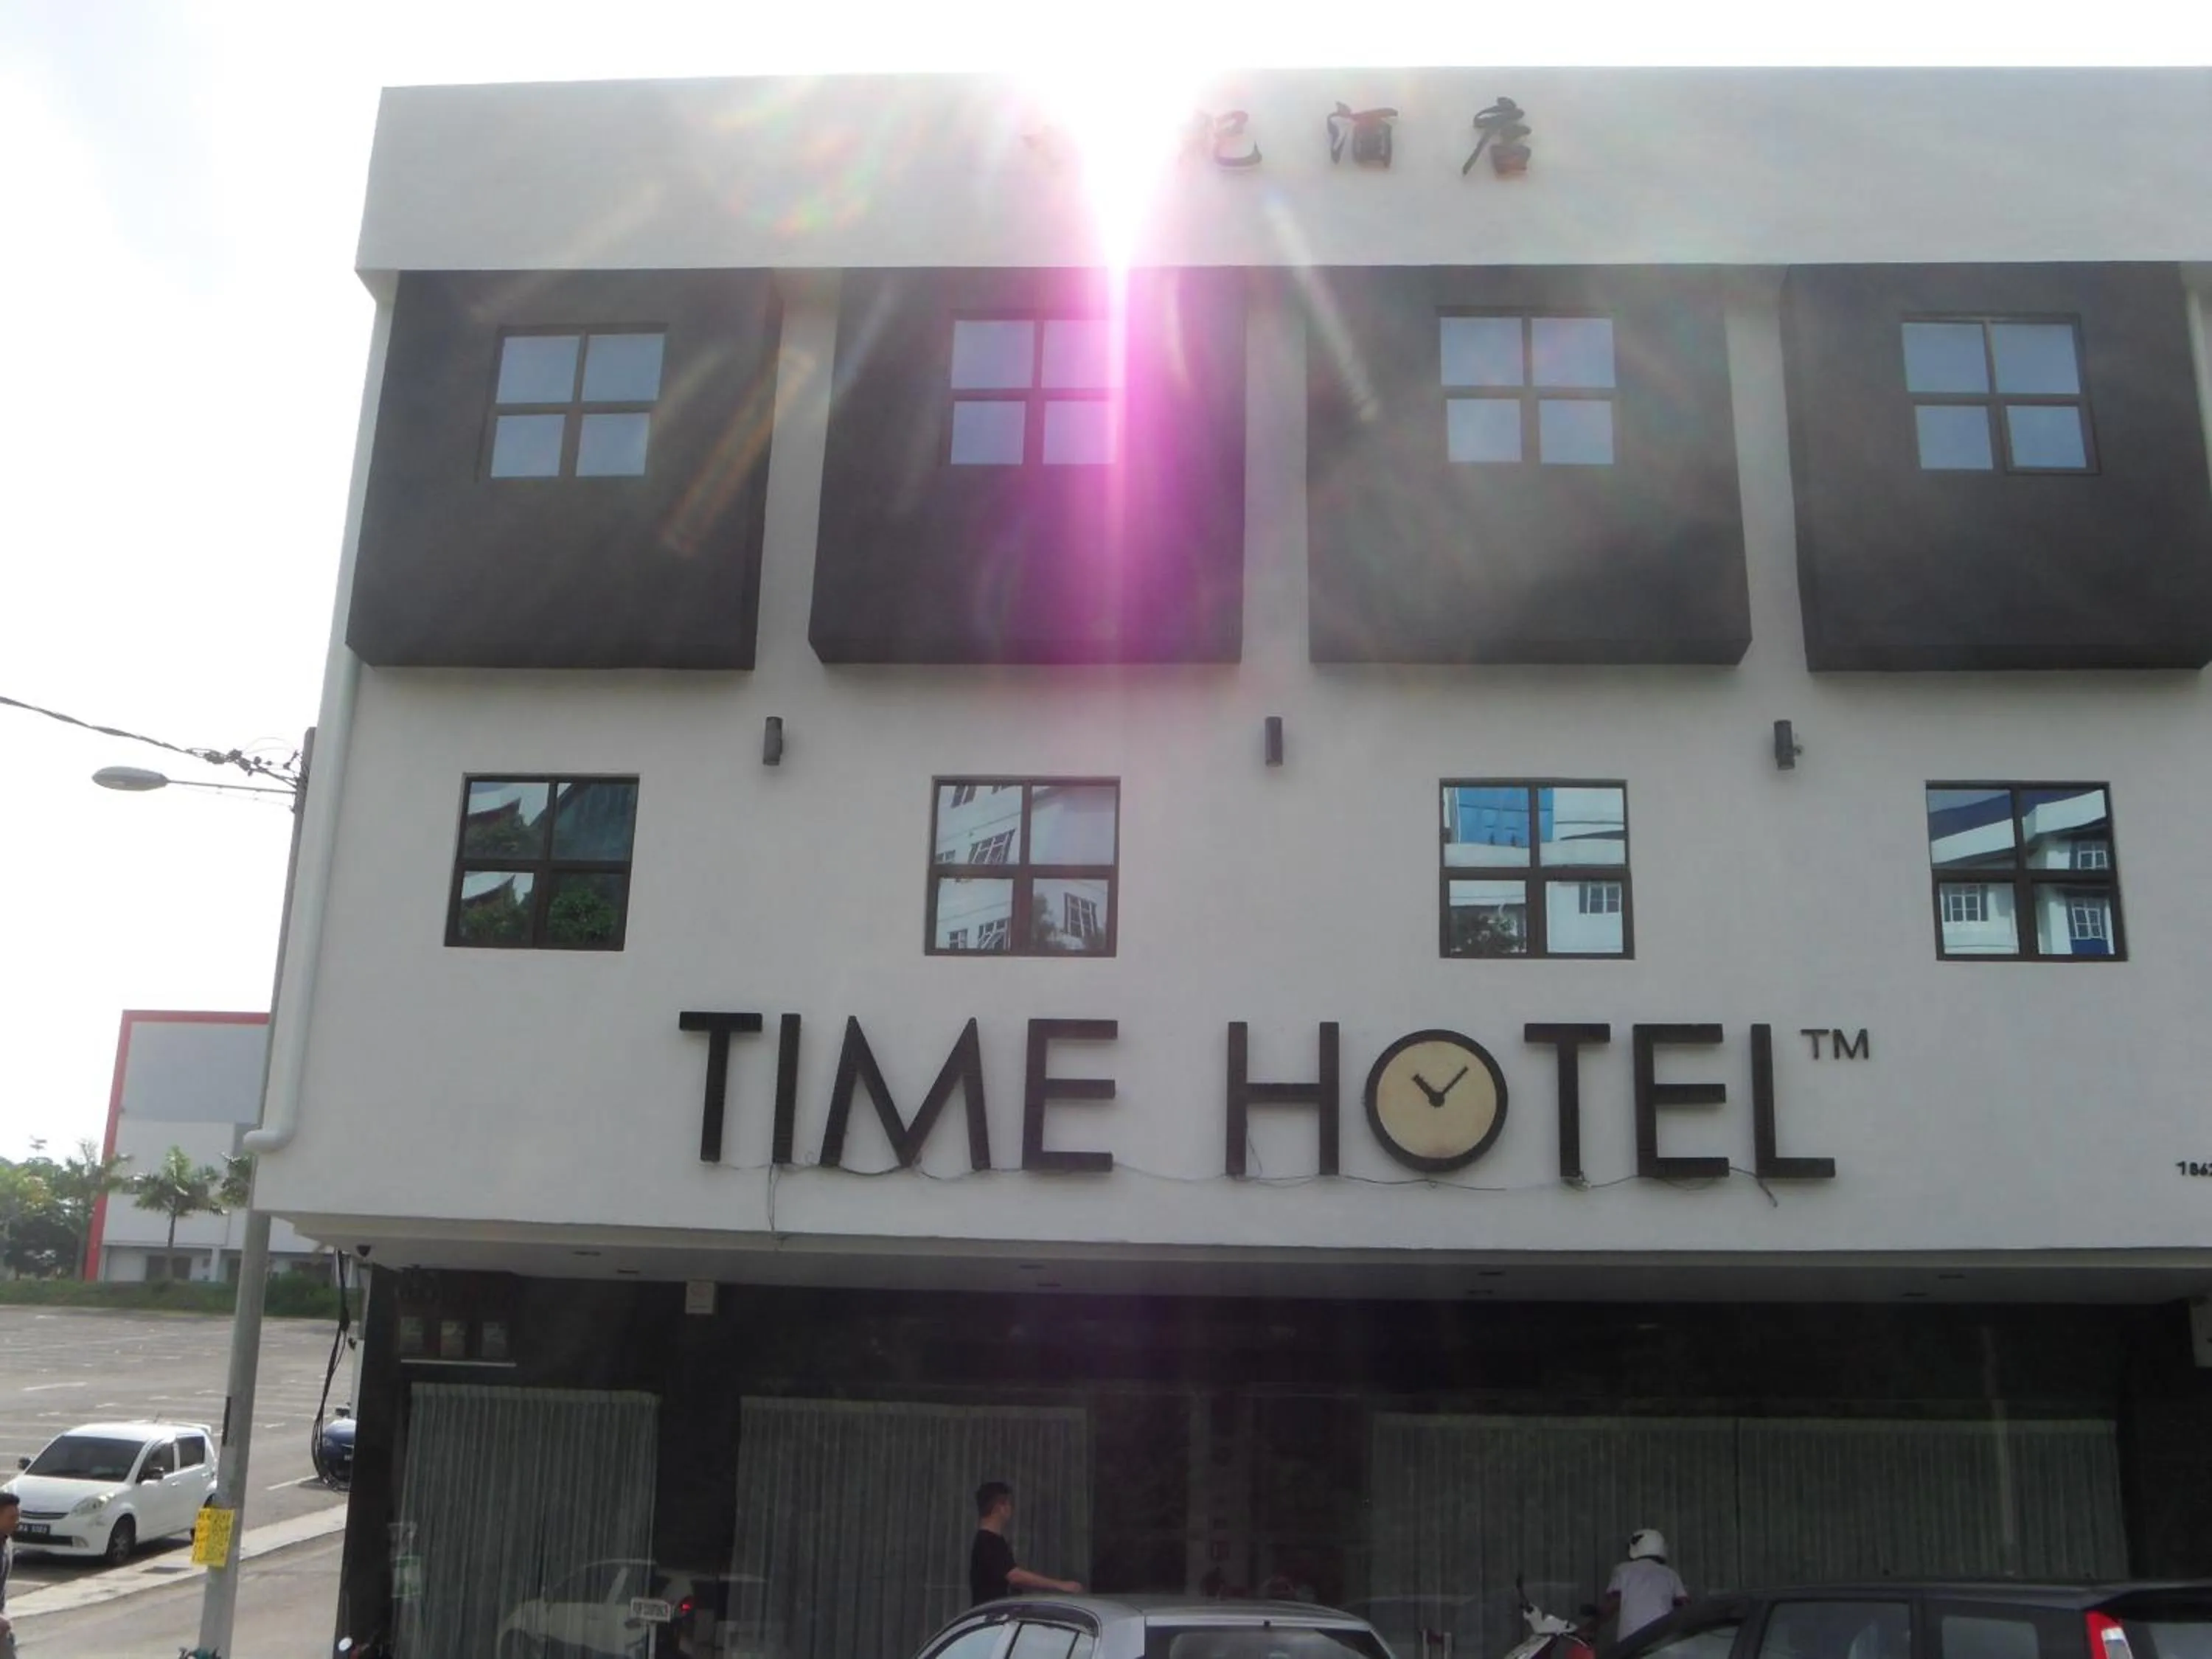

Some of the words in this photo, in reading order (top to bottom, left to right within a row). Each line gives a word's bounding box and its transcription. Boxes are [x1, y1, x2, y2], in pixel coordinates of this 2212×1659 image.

[679, 1011, 1119, 1172] TIME
[1225, 1020, 1836, 1179] HOTEL
[1800, 1028, 1870, 1060] TM
